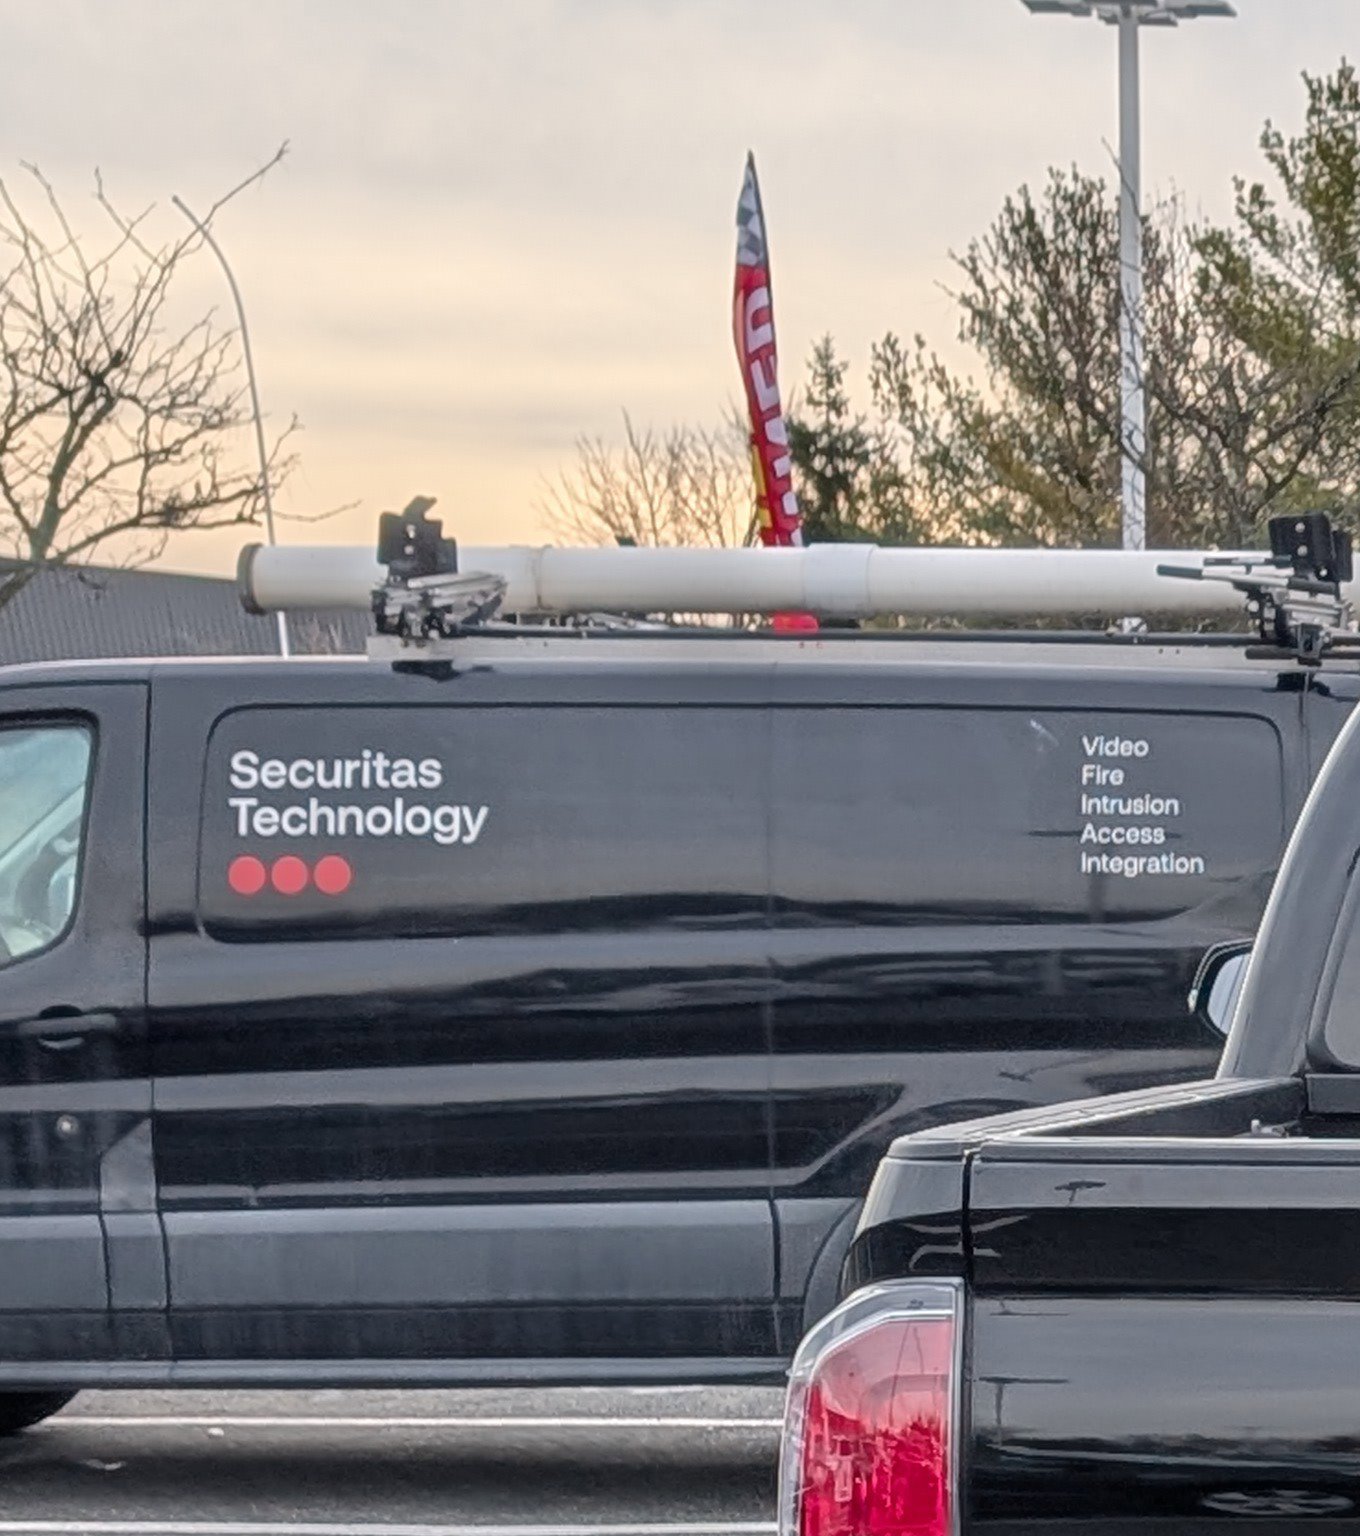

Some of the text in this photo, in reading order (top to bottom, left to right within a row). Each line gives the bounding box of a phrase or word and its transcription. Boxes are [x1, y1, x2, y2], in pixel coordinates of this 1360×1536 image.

[1082, 735, 1149, 757] Video
[229, 749, 443, 789] Securitas
[1081, 764, 1125, 786] Fire
[1081, 794, 1180, 816] Intrusion
[228, 797, 489, 844] Technology
[1080, 823, 1166, 844] Access
[1081, 852, 1205, 877] Integration
